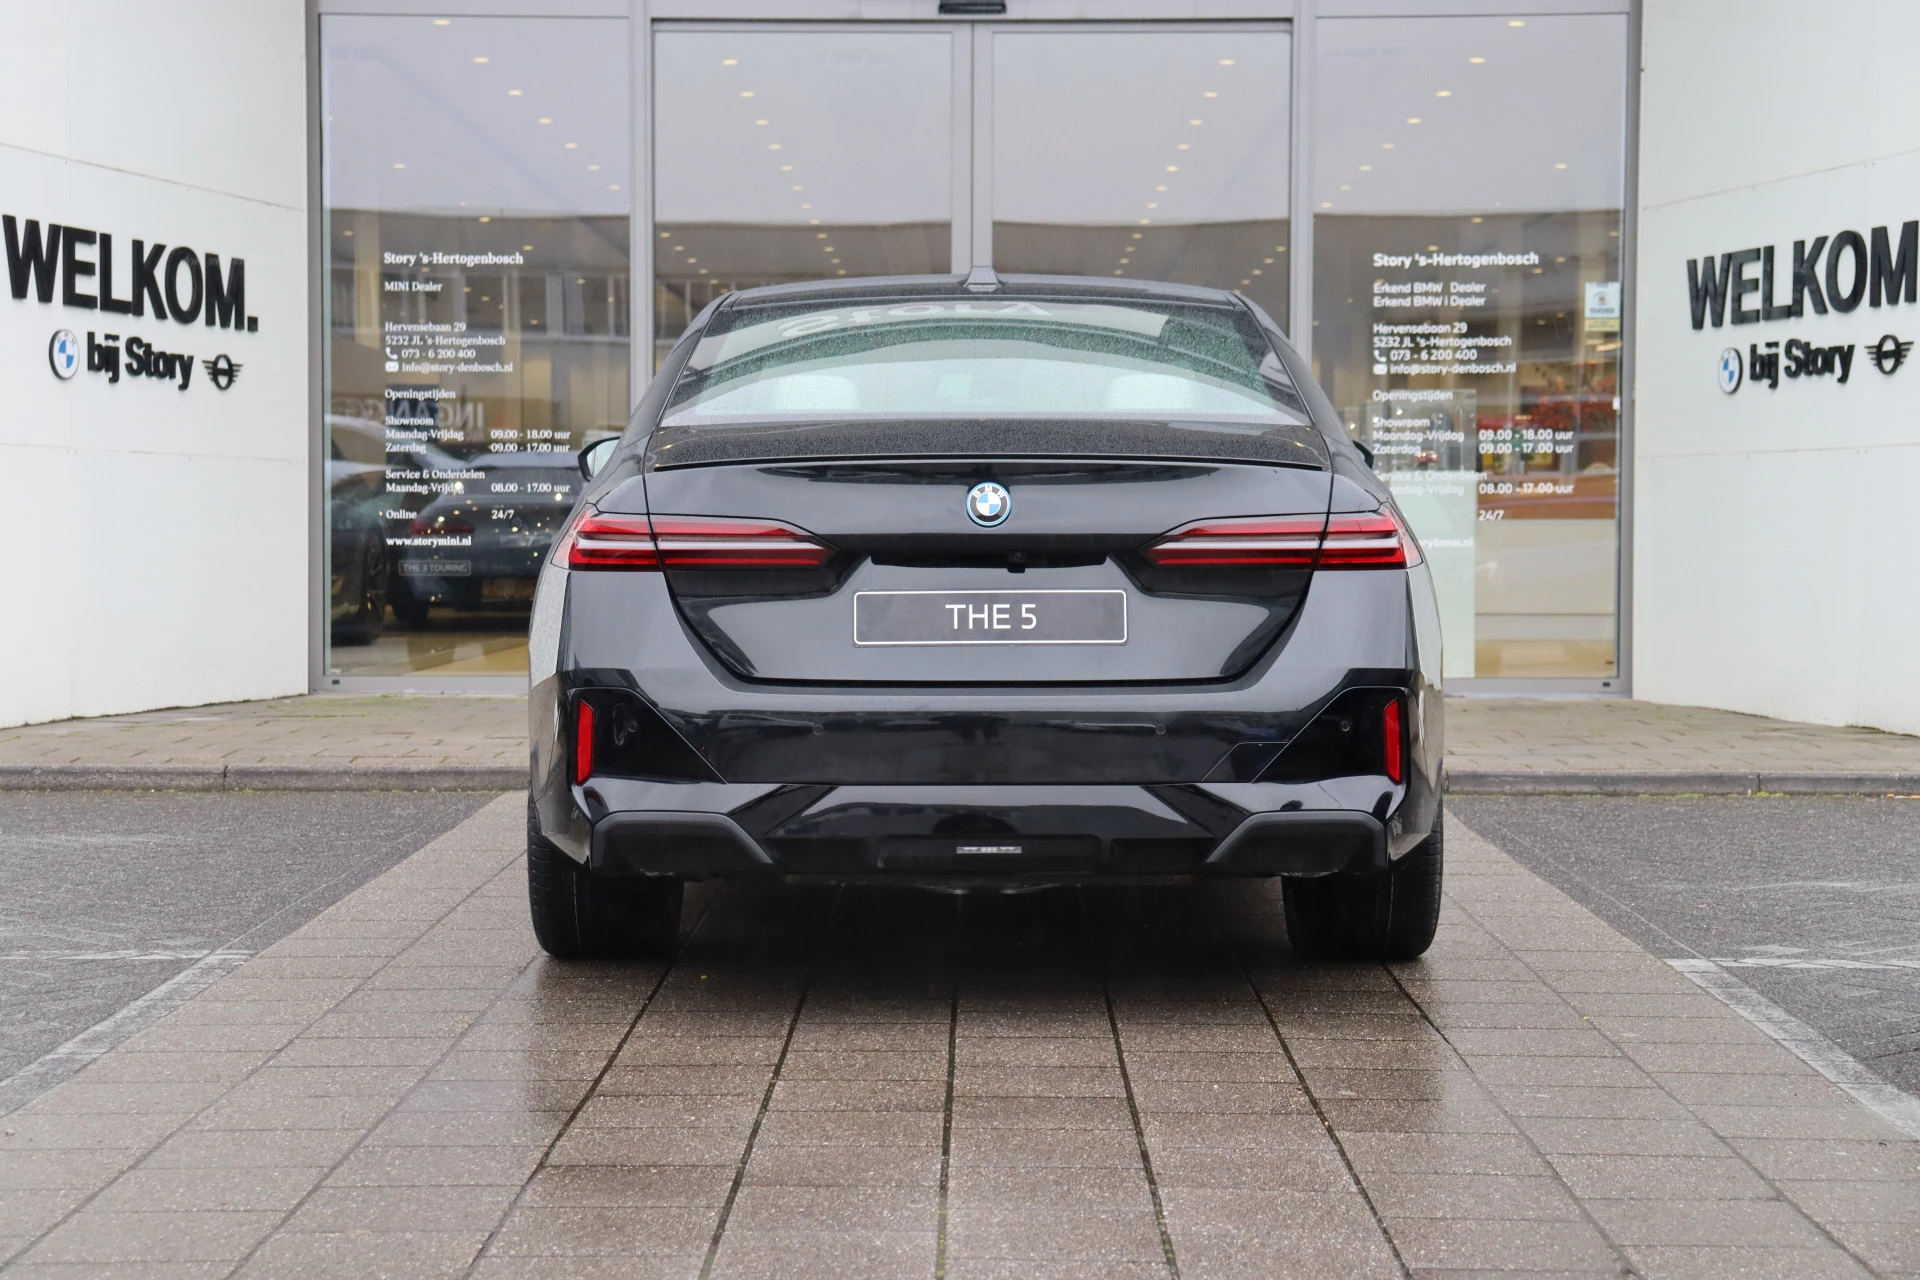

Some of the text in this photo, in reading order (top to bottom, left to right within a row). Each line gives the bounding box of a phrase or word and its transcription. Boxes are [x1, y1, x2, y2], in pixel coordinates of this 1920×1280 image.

[384, 252, 416, 267] Story
[1373, 252, 1539, 269] Story 's-Hertogenbosch
[2, 214, 259, 332] WELKOM.
[1687, 220, 1919, 330] WELKOM
[384, 281, 443, 292] MINI Dealer
[1373, 282, 1486, 294] Erkend BMW Dealer
[1373, 296, 1411, 308] Erkend
[1413, 296, 1442, 307] BMW
[1450, 296, 1486, 307] Dealer
[385, 322, 466, 332] Hervensebaan 29
[1373, 322, 1468, 334] Hervensebaan 29
[385, 335, 409, 346] 5232
[411, 335, 423, 347] JL
[1373, 337, 1401, 348] 5232
[1402, 337, 1415, 349] JL
[401, 349, 420, 359] 073
[428, 349, 435, 359] 6
[437, 349, 455, 359] 200
[457, 349, 476, 359] 400
[1390, 350, 1411, 361] 073
[1421, 350, 1428, 361] 6
[1430, 350, 1453, 361] 200
[1455, 349, 1477, 361] 400
[87, 331, 120, 383] bij
[125, 336, 194, 390] Story
[1749, 338, 1856, 389] bij Story
[402, 361, 514, 374] info@story-denbosch.nl
[1390, 363, 1517, 376] info@story-denbosch.nl
[385, 389, 456, 401] Openingstijden
[1372, 389, 1453, 402] Openingstijden
[385, 416, 434, 426] Showroom
[1373, 417, 1430, 428] Showroom
[385, 429, 465, 441] Maandag-Vrijdag
[490, 430, 518, 439] 09.00
[527, 430, 552, 439] 18.00
[554, 431, 571, 439] uur
[1373, 430, 1465, 443] Maandag-Vrijdag
[1479, 429, 1513, 440] 09.00
[1522, 429, 1553, 440] 18.00
[1555, 430, 1574, 440] uur
[385, 443, 427, 454] Zaterdag
[490, 443, 518, 453] 09.00
[527, 443, 552, 453] 17.00
[553, 445, 571, 453] uur
[1373, 443, 1421, 456] Zaterdag
[1479, 443, 1513, 454] 09.00
[1555, 444, 1574, 454] uur
[385, 469, 485, 479] Service & Onderdelen
[1426, 470, 1488, 481] Onderdelen
[491, 483, 518, 493] 08.00
[527, 483, 552, 493] 17.00
[553, 485, 571, 493] uur
[1479, 483, 1513, 494] 08.00
[1555, 485, 1575, 494] uur
[386, 510, 514, 520] Online 24/7
[1479, 510, 1504, 521] 24/7
[386, 536, 472, 548] www.storymini.nl
[403, 564, 468, 573] THE 3 TOURING
[945, 603, 1037, 630] THE 5
